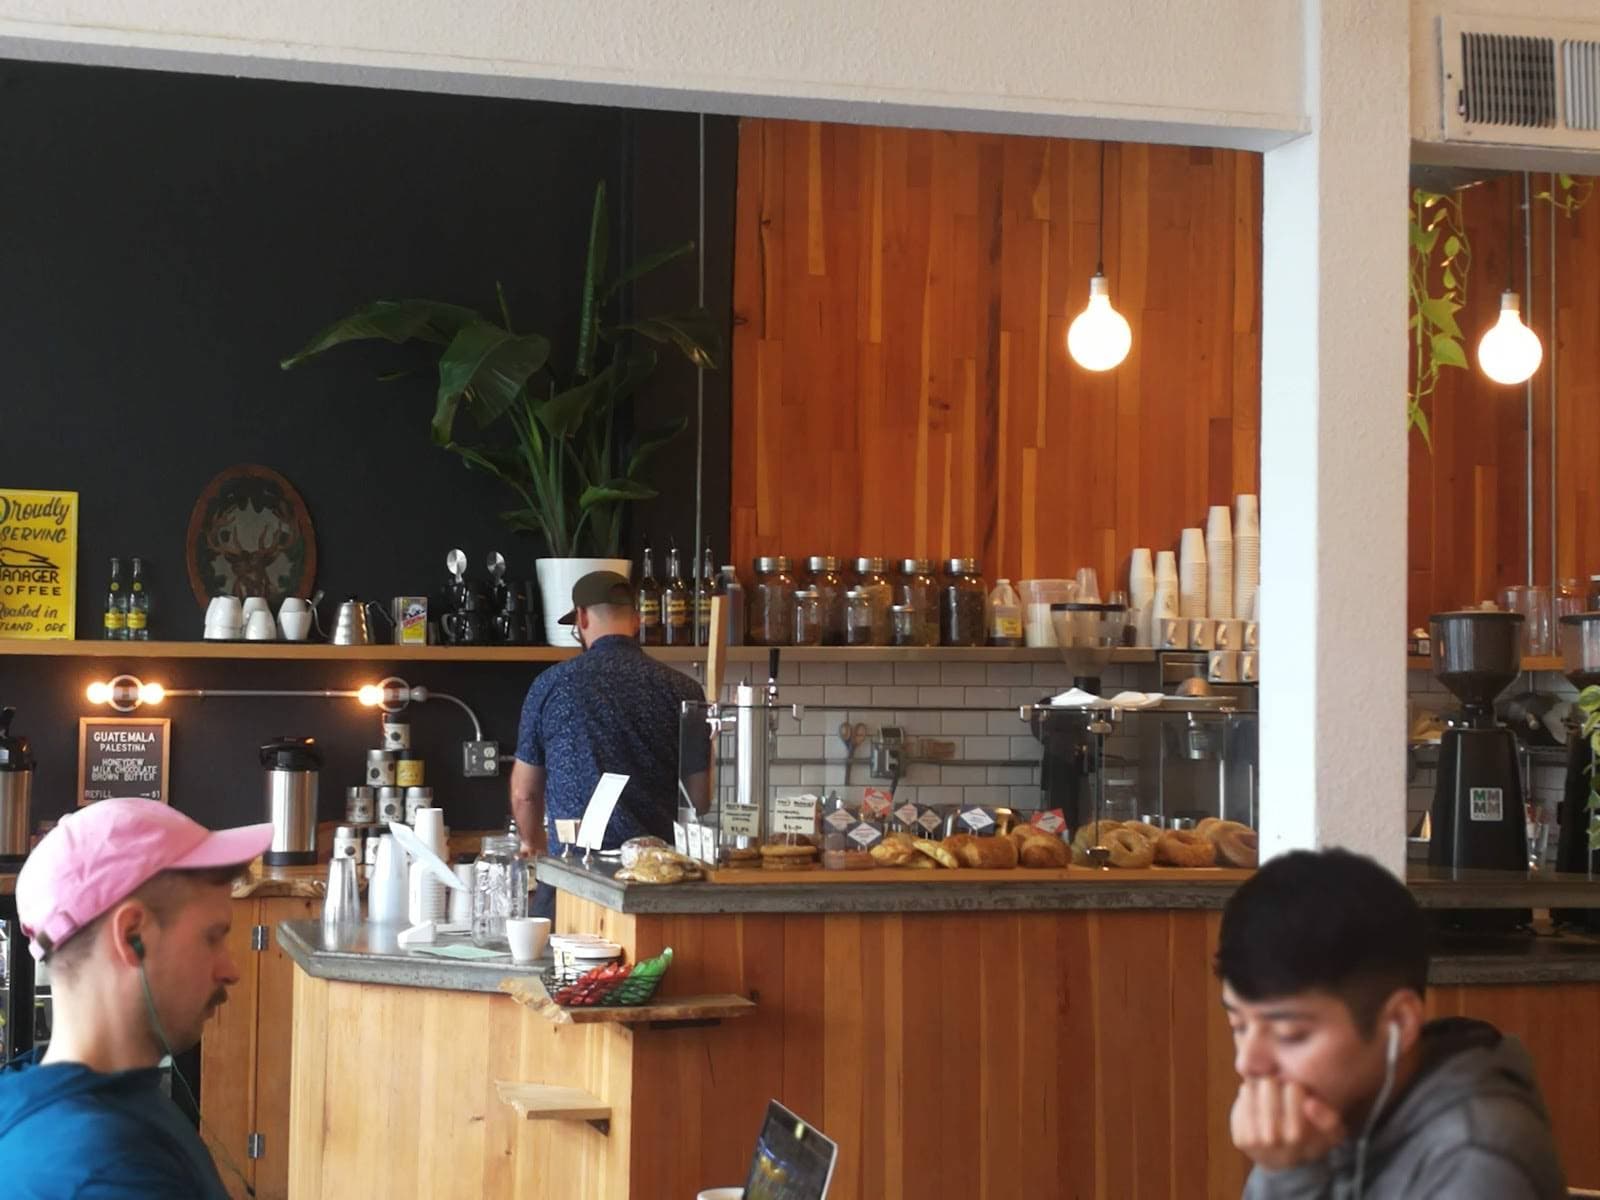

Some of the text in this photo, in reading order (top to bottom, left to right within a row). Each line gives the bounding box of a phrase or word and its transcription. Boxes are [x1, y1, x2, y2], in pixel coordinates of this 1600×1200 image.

[1, 526, 67, 543] SERVING
[0, 569, 60, 584] ANAGER
[0, 585, 61, 596] OFFEE
[44, 605, 58, 618] in
[94, 731, 155, 743] GUATEMALA
[100, 743, 146, 752] PALESTINA
[115, 765, 158, 775] CHOCOLATE
[124, 772, 154, 782] BUTTER
